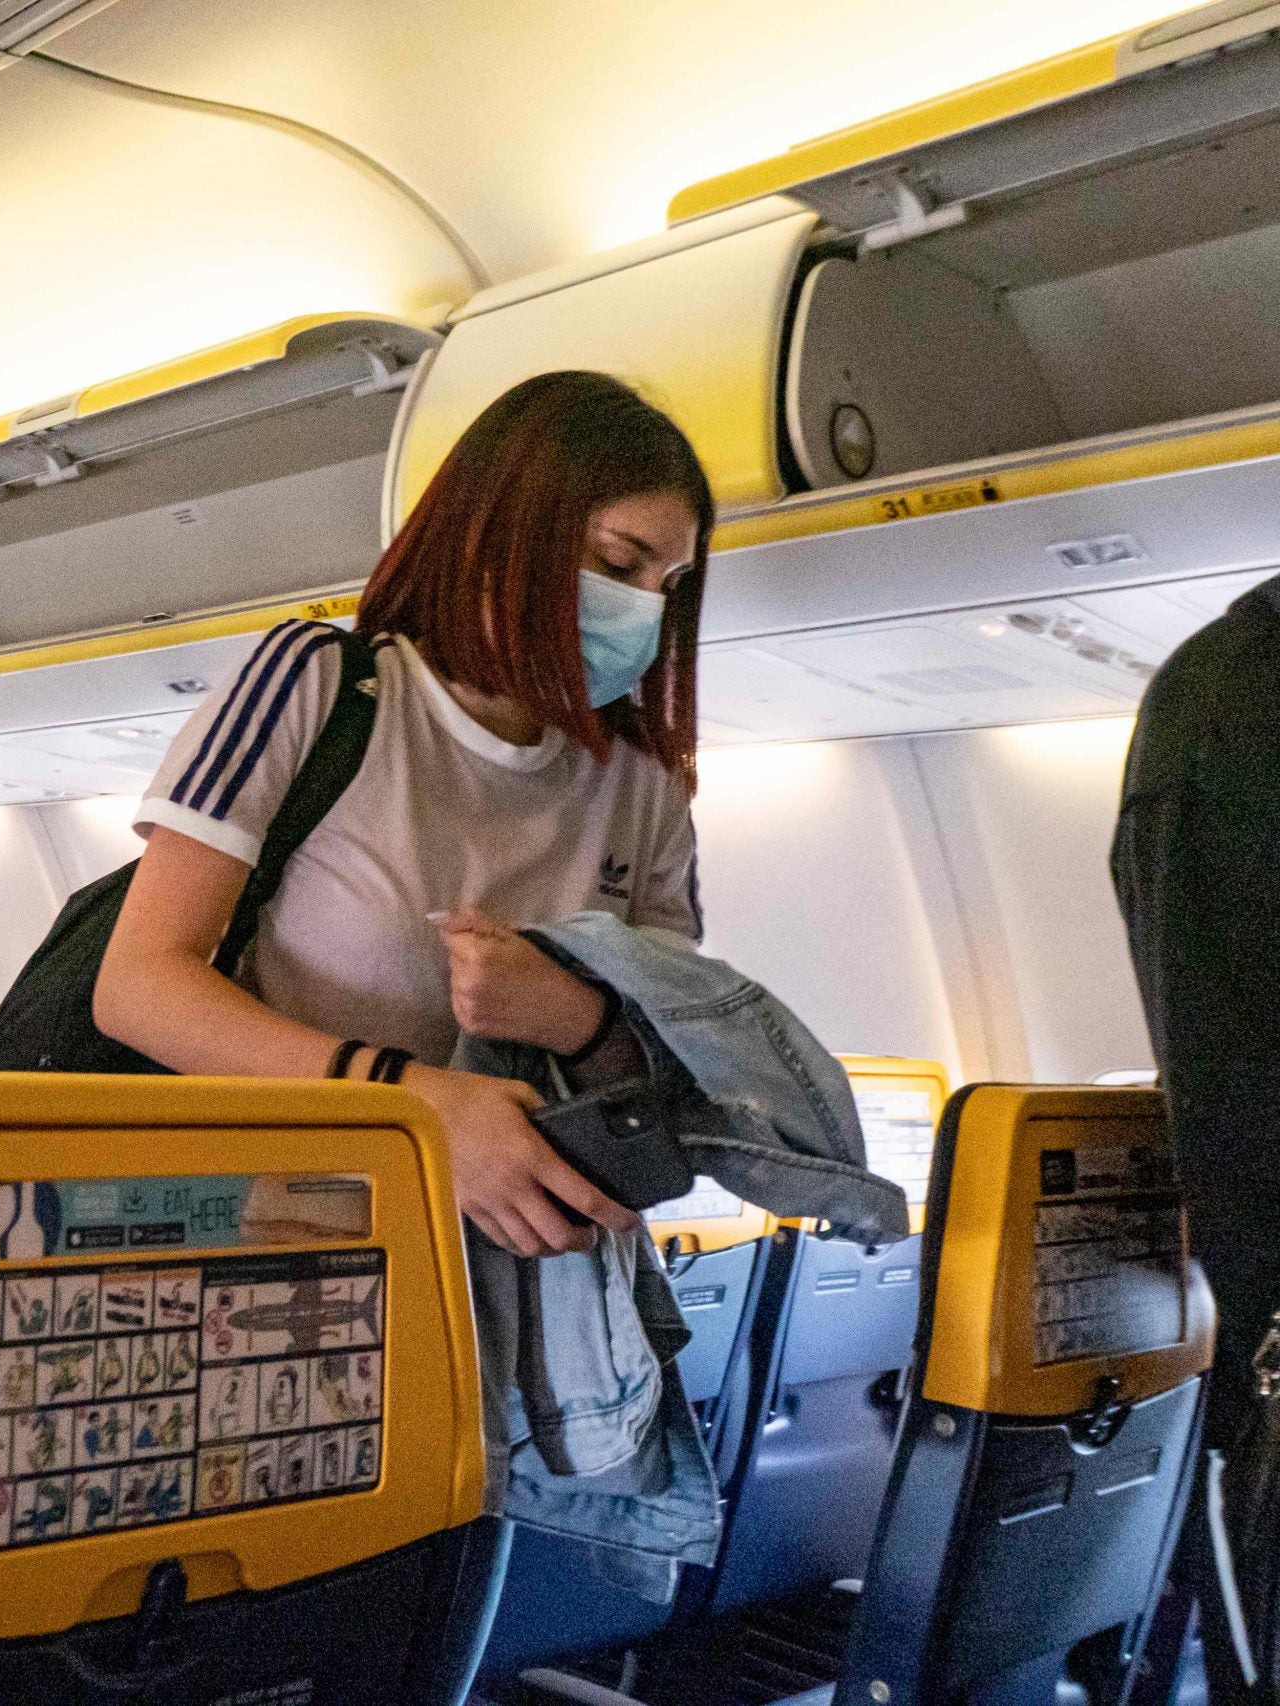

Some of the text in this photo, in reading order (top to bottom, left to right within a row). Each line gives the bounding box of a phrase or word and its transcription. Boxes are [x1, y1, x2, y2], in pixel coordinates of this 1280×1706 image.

[881, 496, 910, 519] 31
[307, 603, 329, 619] 30
[163, 1187, 191, 1216] EAT
[189, 1194, 240, 1233] HERE
